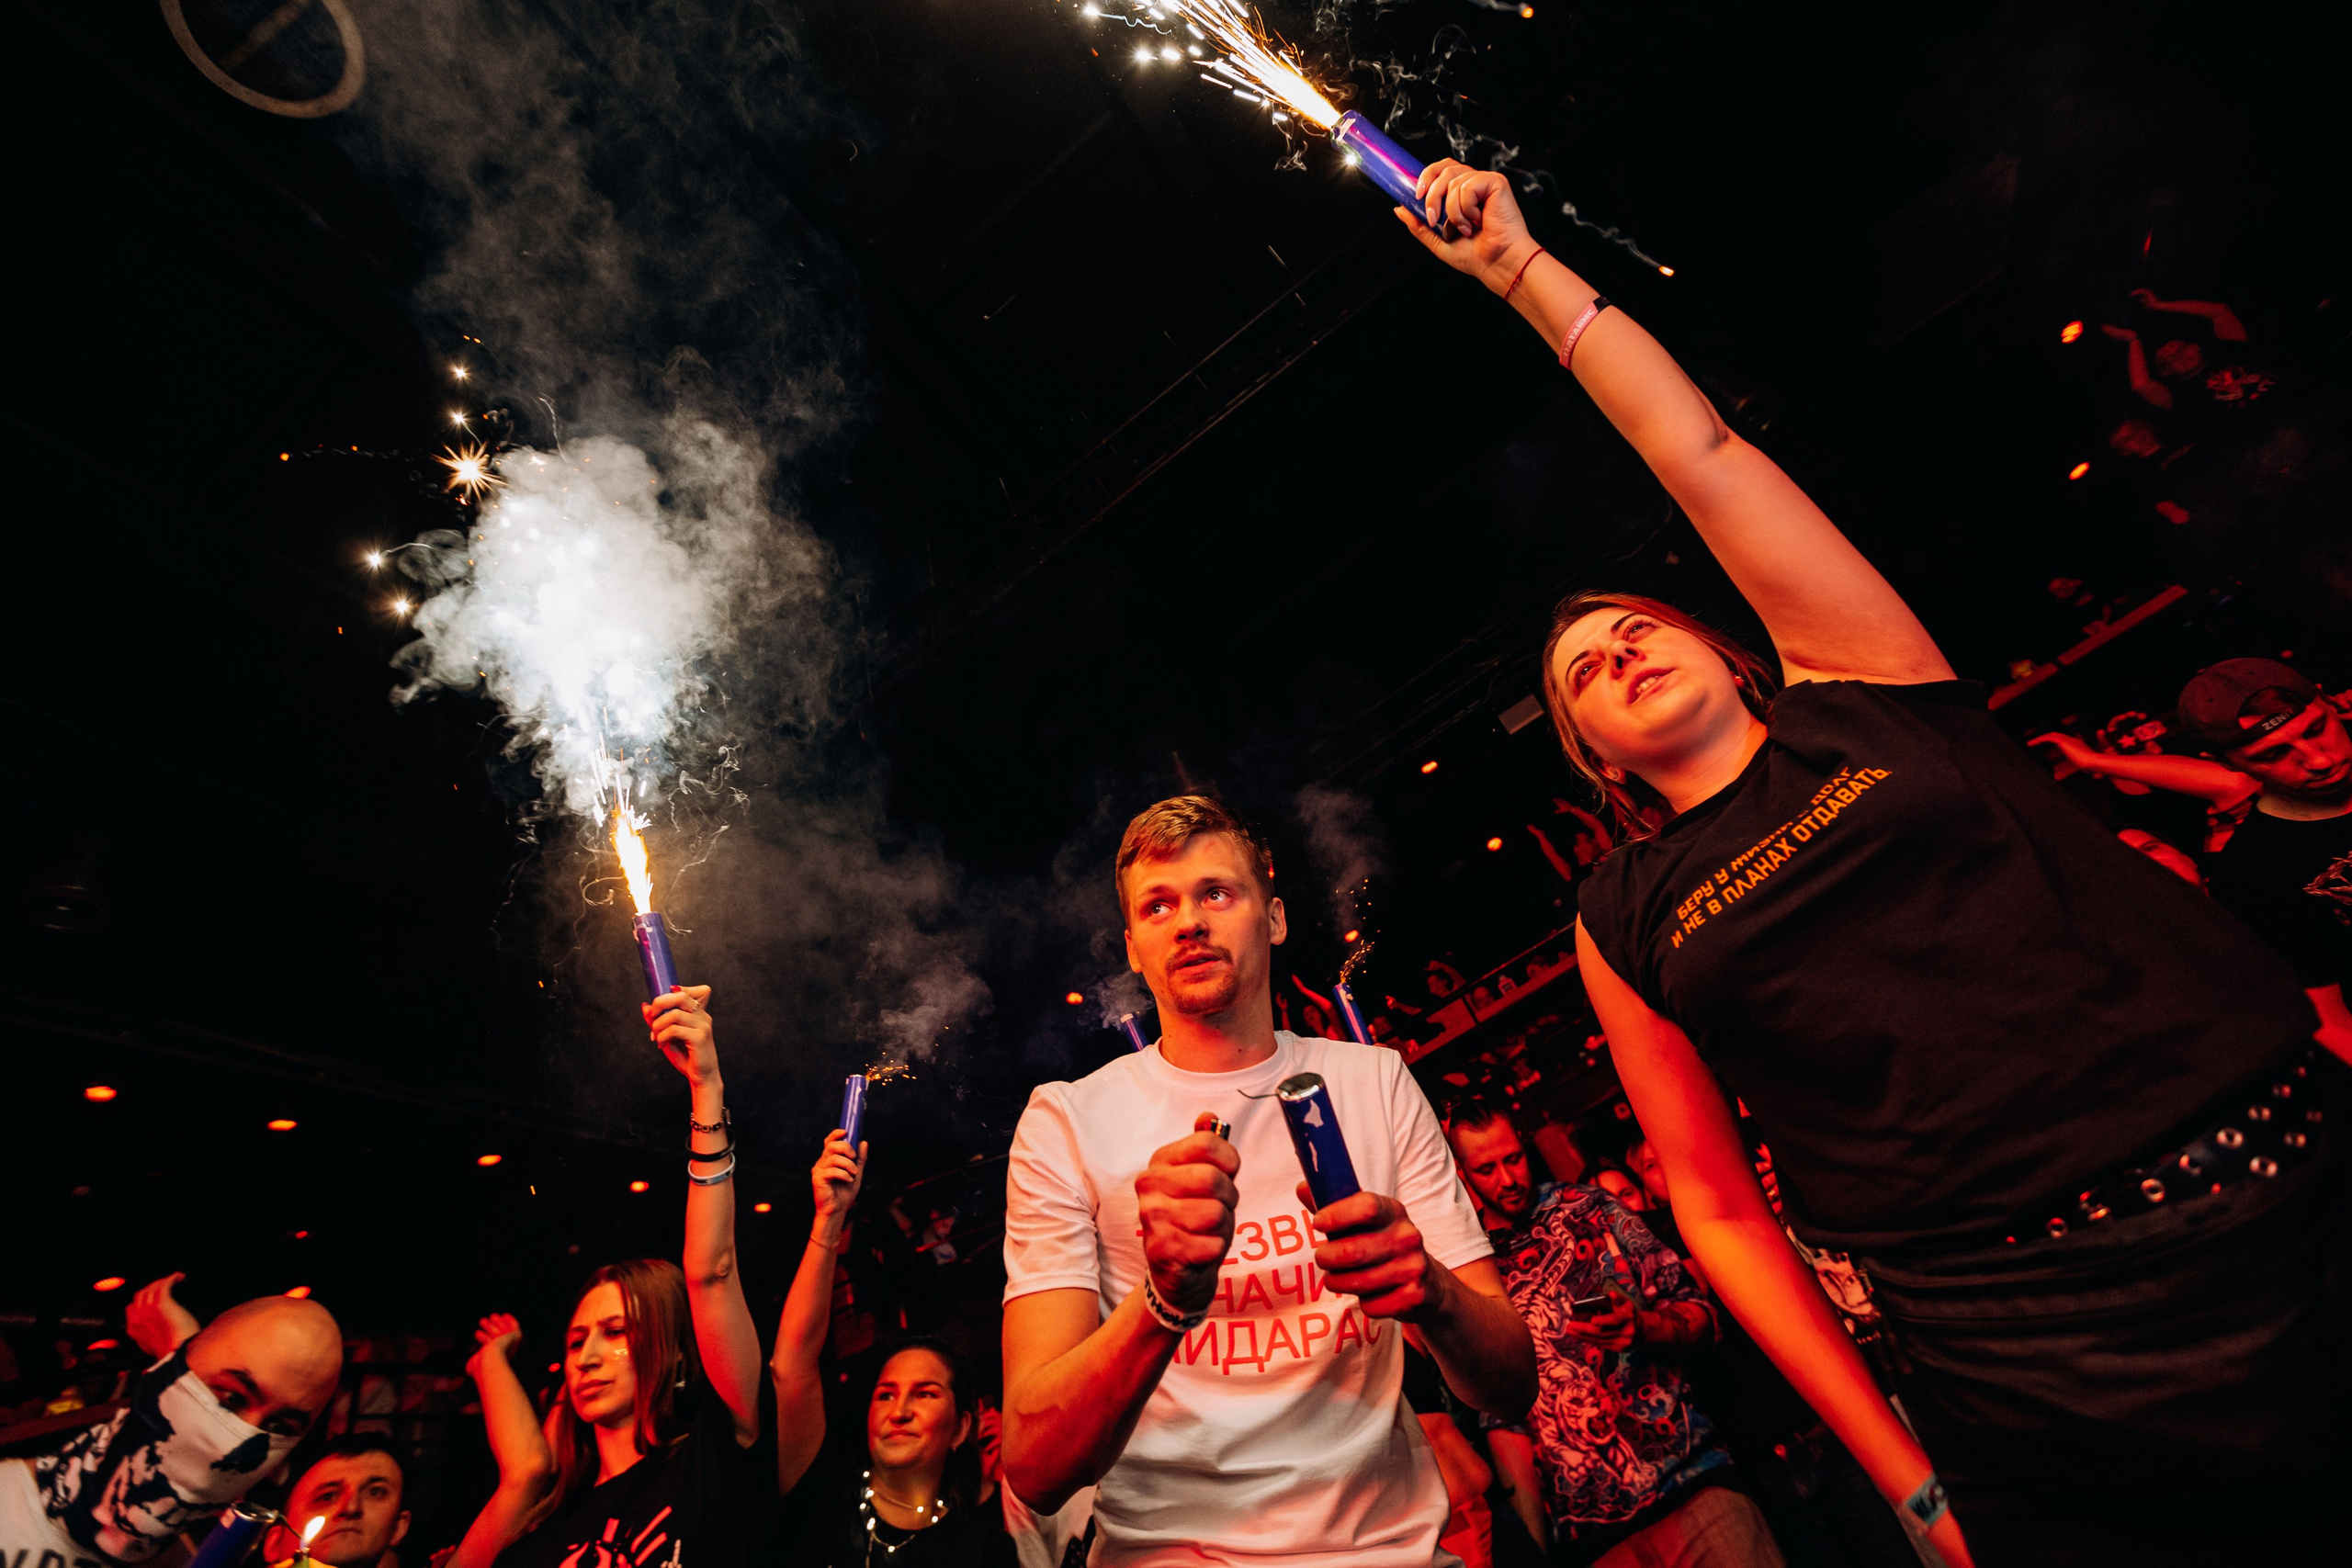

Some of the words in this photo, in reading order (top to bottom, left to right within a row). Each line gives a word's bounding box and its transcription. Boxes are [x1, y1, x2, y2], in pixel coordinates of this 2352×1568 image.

[1676, 880, 1715, 920] БЕРУ
[1714, 868, 1729, 885] У
[1810, 766, 1851, 806] ДОЛГ
[1670, 930, 1684, 948] И
[1683, 909, 1706, 934] НЕ
[1705, 898, 1723, 915] В
[1721, 837, 1798, 904] ПЛАНАХ
[1214, 1261, 1342, 1314] НАЧИ
[1172, 1307, 1382, 1376] ИДАРАС
